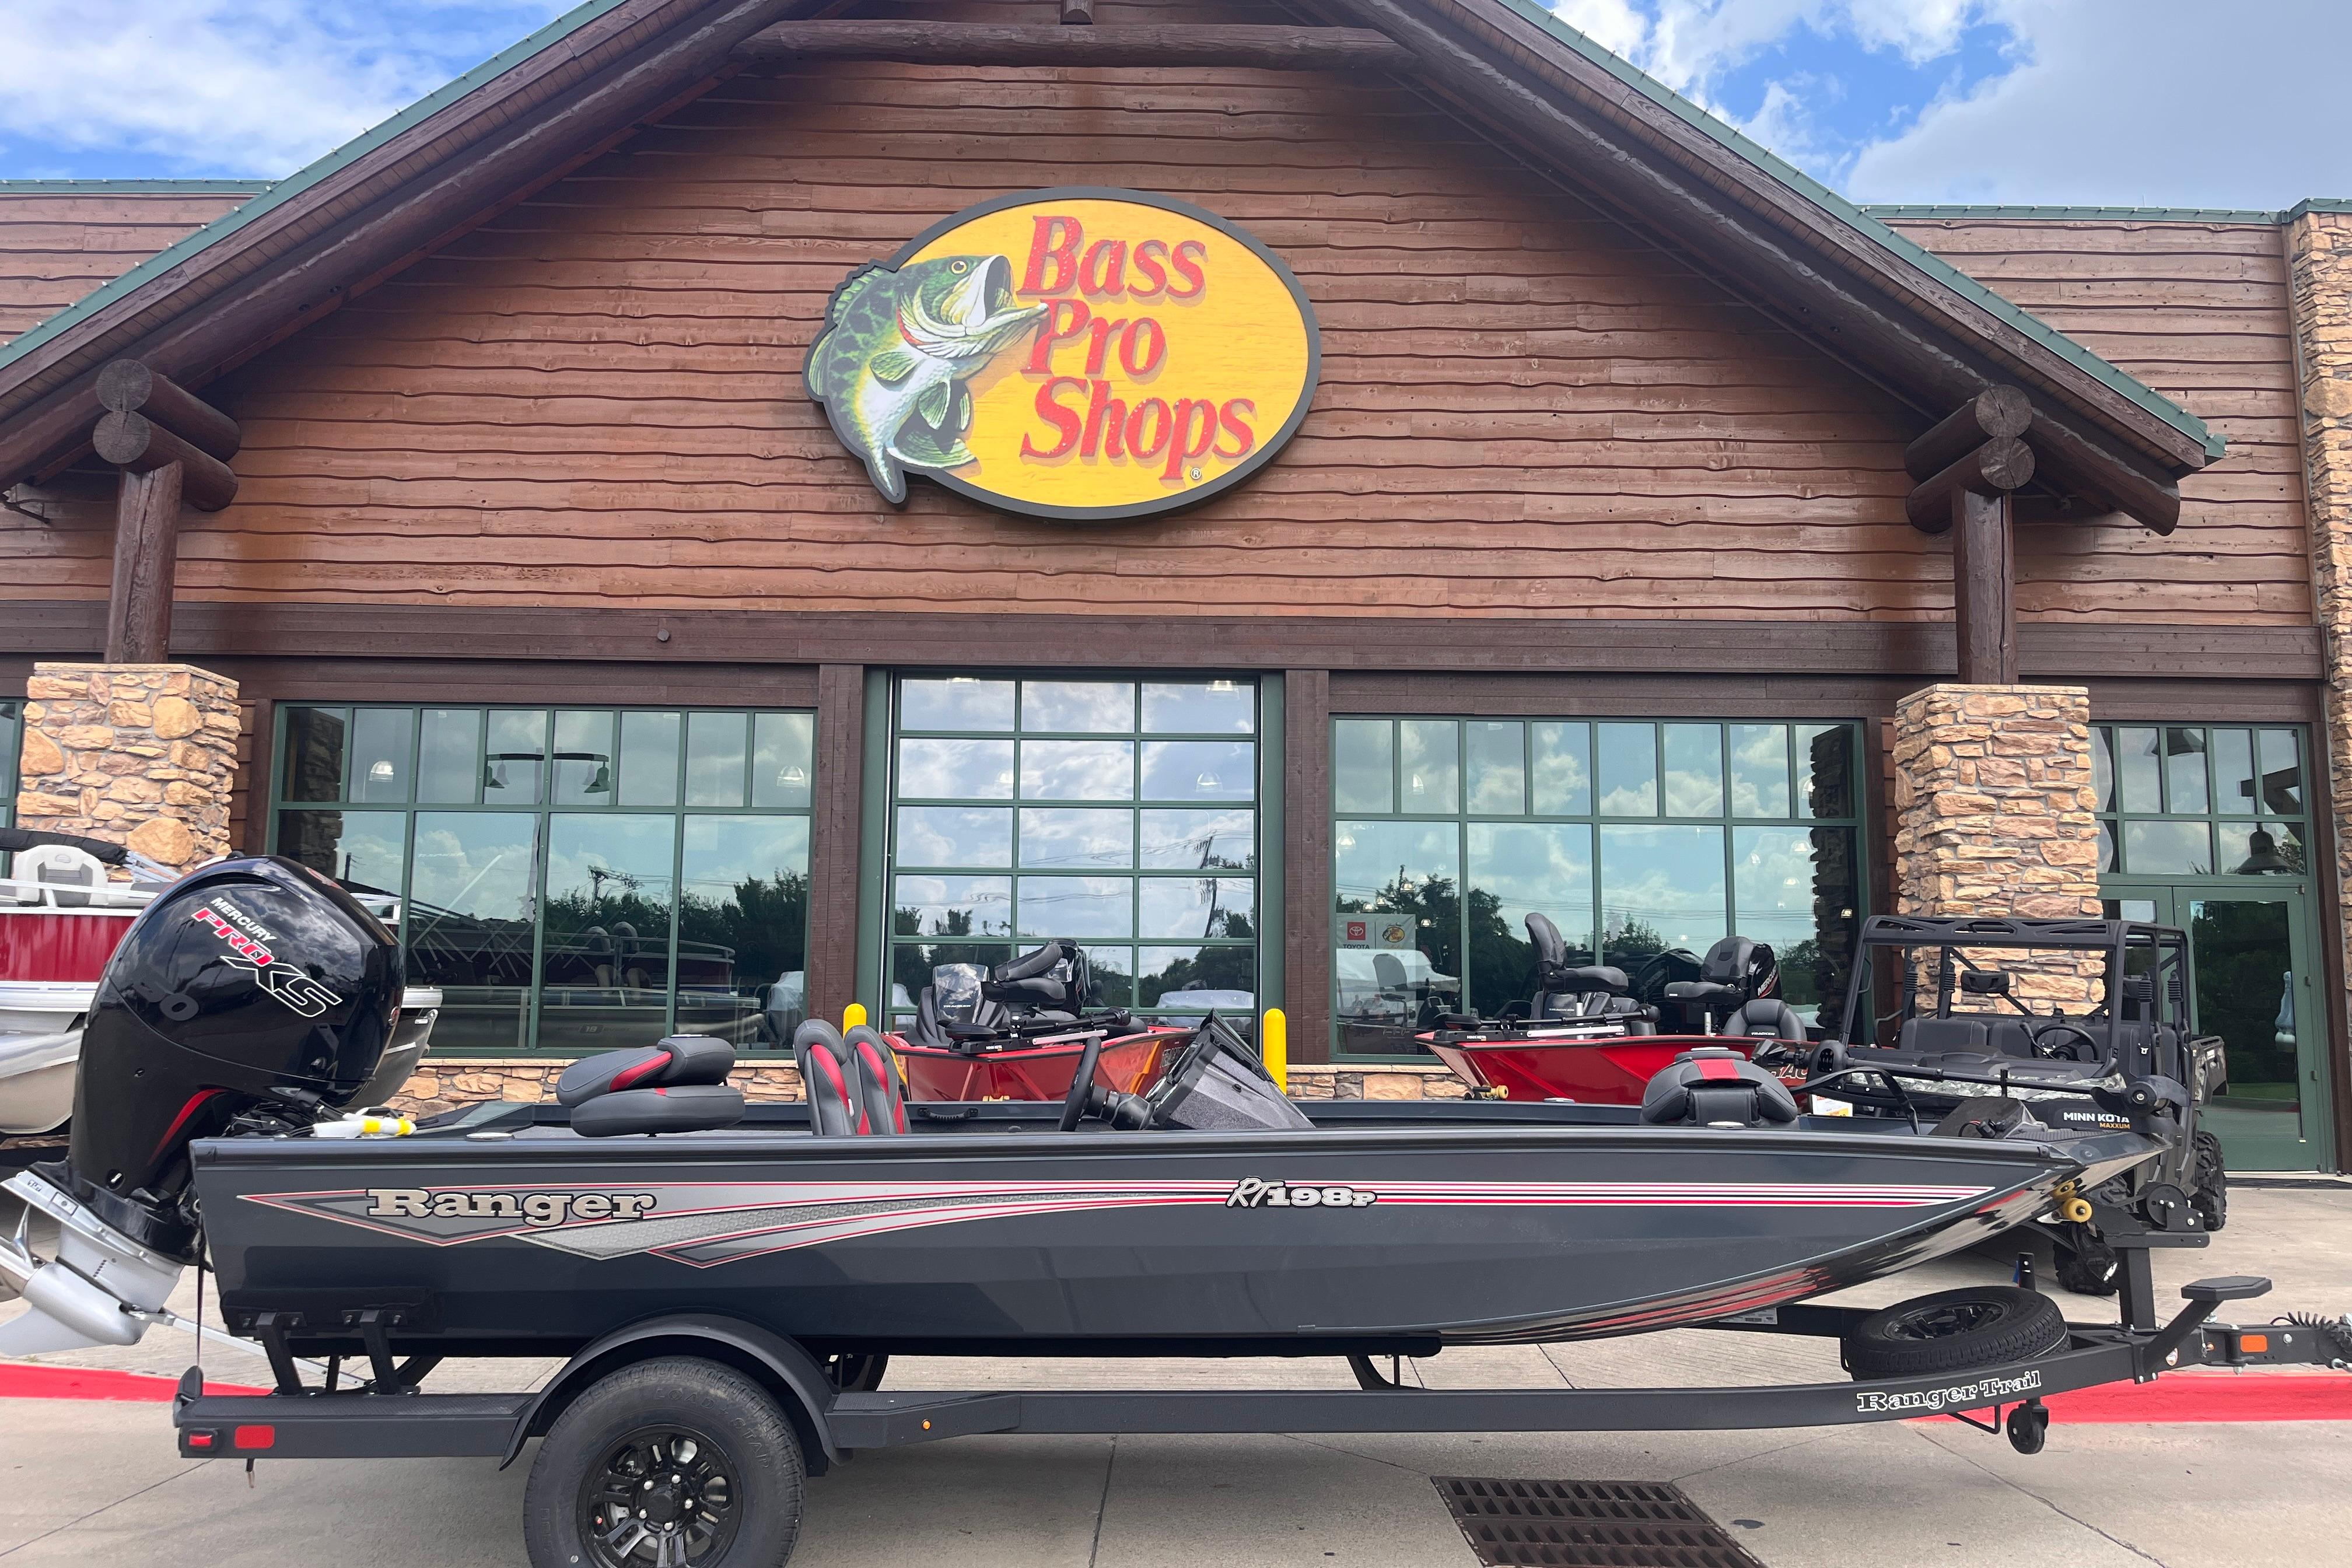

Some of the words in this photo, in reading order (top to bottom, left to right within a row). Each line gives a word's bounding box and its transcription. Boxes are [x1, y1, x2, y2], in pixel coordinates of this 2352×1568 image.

[1015, 215, 1208, 298] Bass
[1020, 298, 1167, 377] Pro
[1020, 377, 1256, 480] Shops
[191, 907, 275, 967] PRO
[211, 897, 277, 942] MERCURY
[2063, 1112, 2095, 1121] MINN
[366, 1188, 657, 1227] Ranger
[1857, 1384, 1978, 1412] Ranger
[1979, 1370, 2042, 1398] Trail
